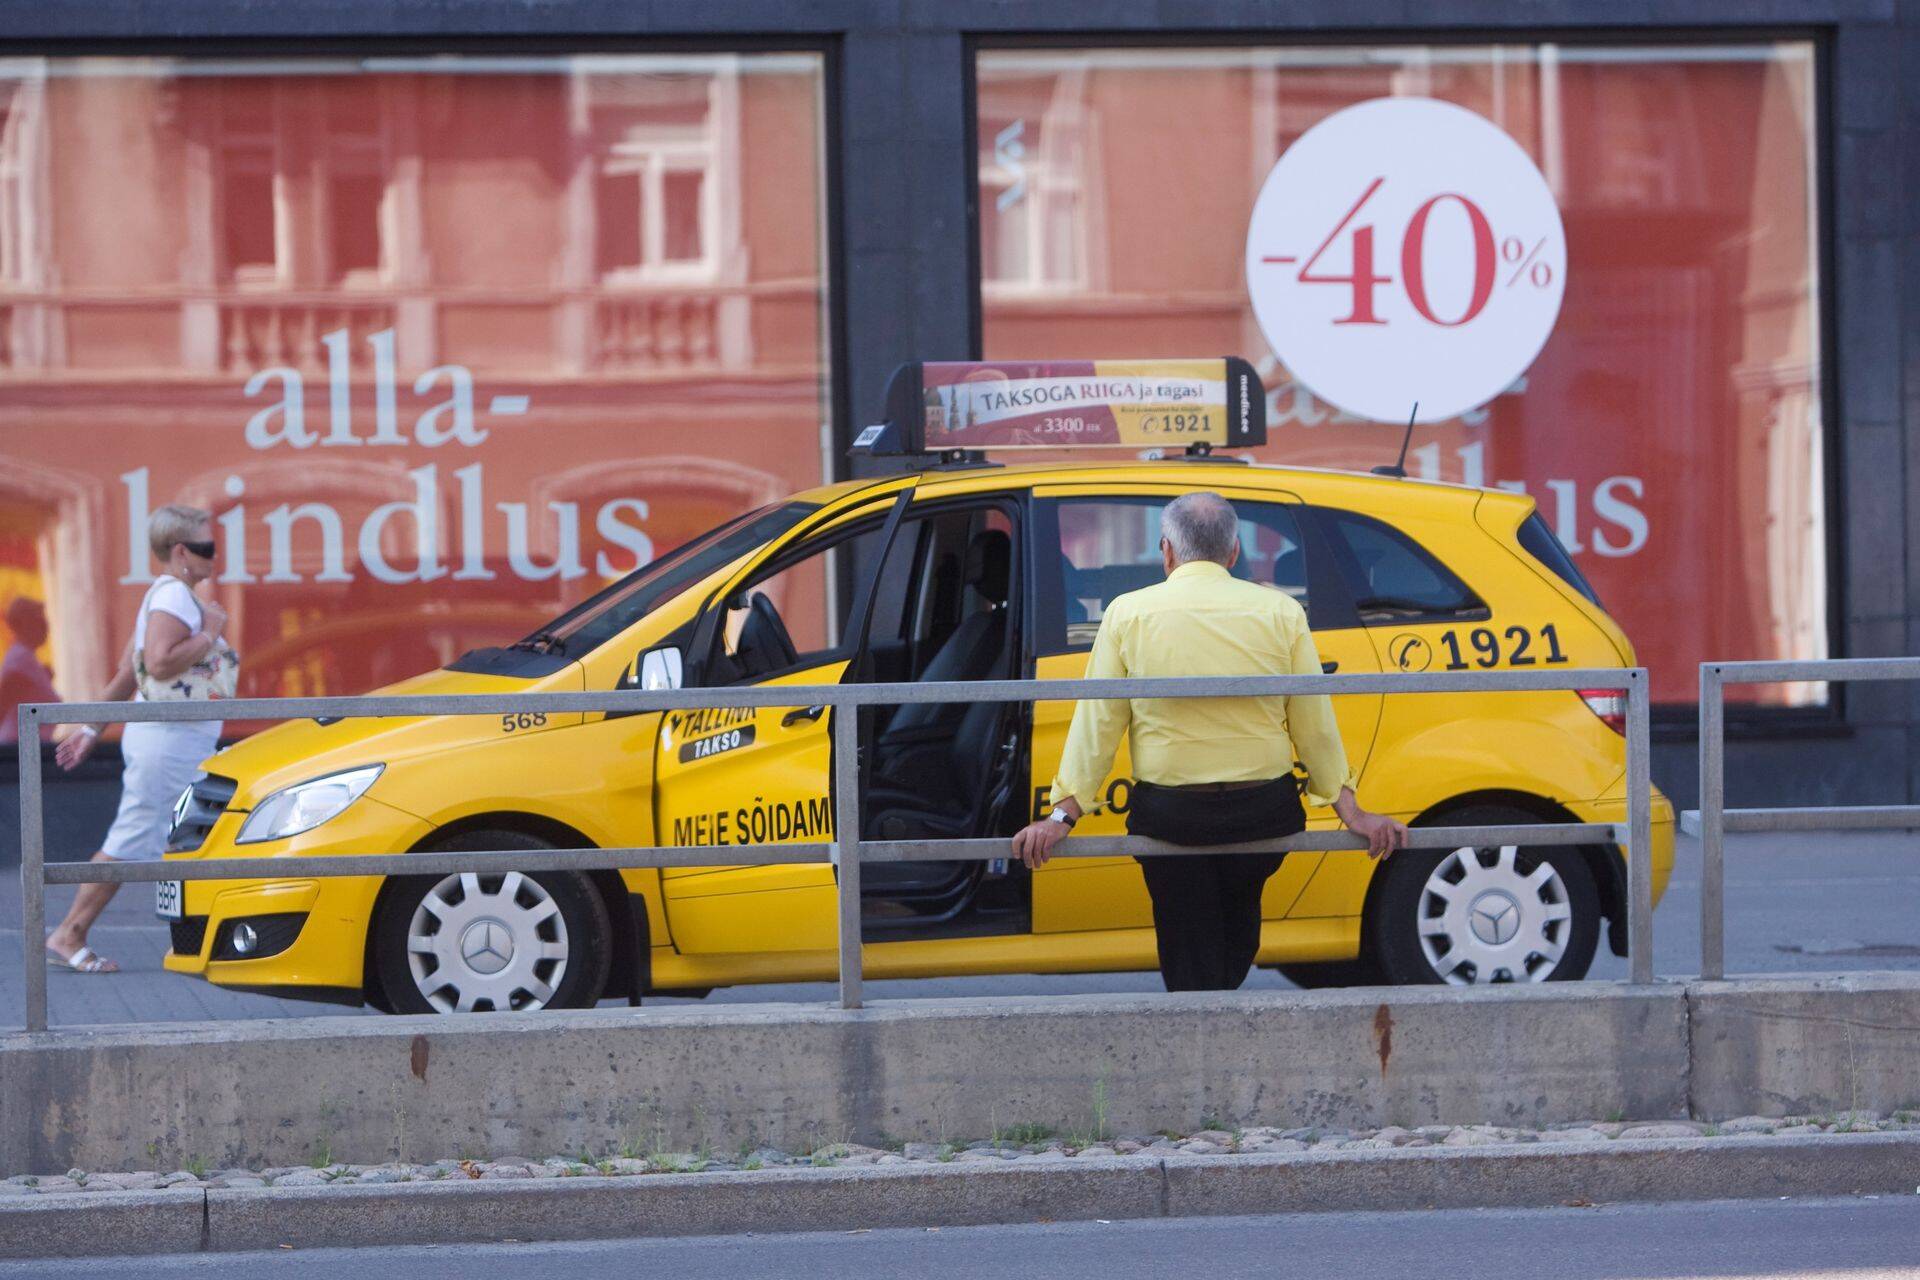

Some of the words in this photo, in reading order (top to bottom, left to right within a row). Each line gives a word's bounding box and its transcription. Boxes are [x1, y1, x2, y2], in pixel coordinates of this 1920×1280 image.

[1262, 176, 1552, 327] -40%
[243, 328, 531, 449] alla-
[980, 385, 1076, 411] TAKSOGA
[1081, 382, 1135, 400] RIIGA
[1139, 383, 1153, 401] ja
[1157, 384, 1204, 400] tagasi
[1044, 417, 1084, 433] 3300
[1162, 414, 1212, 432] 1921
[1440, 622, 1569, 670] 1921
[502, 711, 547, 732] 568
[694, 729, 741, 759] TAKSO
[674, 811, 729, 847] MEIE
